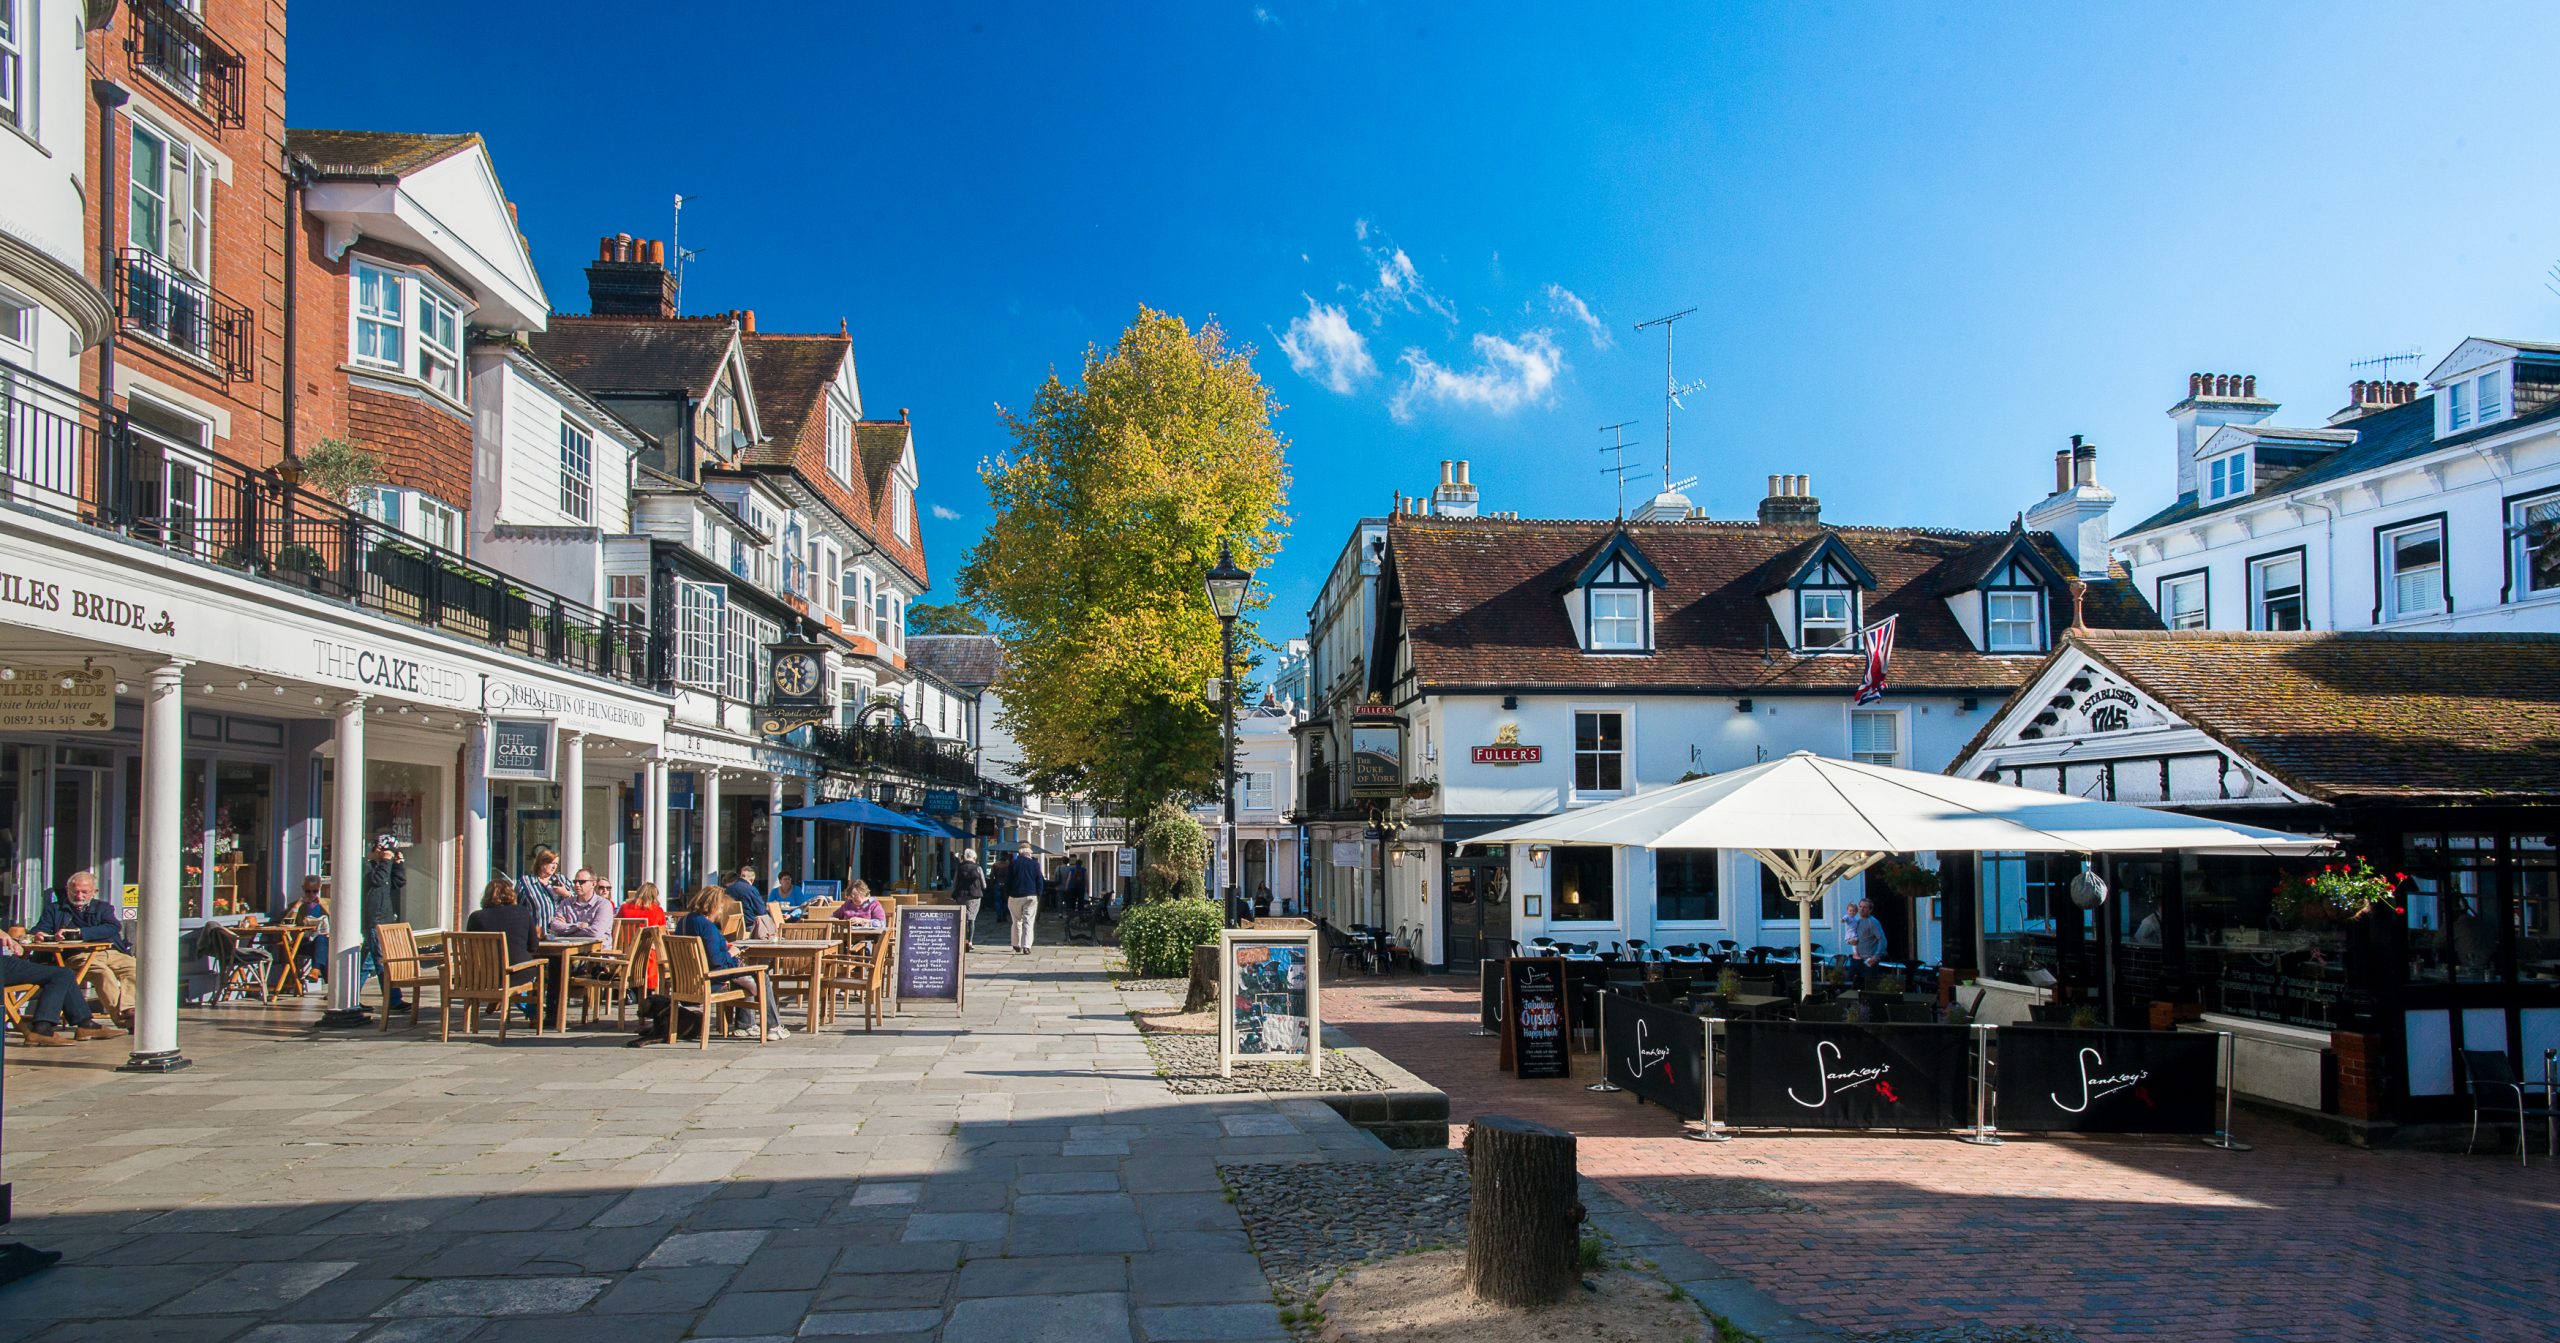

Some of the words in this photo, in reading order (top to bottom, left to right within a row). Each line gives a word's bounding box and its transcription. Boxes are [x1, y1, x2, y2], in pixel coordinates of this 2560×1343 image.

[0, 572, 59, 611] ILES
[72, 589, 146, 631] BRIDE
[15, 670, 48, 681] THE
[50, 684, 106, 697] BRIDE
[25, 698, 60, 710] bridal
[63, 701, 93, 710] wear
[511, 684, 542, 708] JOHN
[543, 691, 571, 713] LEWIS
[573, 697, 587, 716] OF
[588, 700, 645, 728] HUNGERFORD
[2079, 688, 2138, 717] ESTABLISHED
[4, 715, 34, 725] 01892
[38, 715, 55, 725] 514
[59, 715, 76, 725] 515
[2091, 705, 2129, 733] 1745
[499, 733, 524, 745] THE
[498, 744, 538, 756] CAKE
[1477, 748, 1537, 760] FULLER'S
[497, 755, 532, 767] SHED
[1357, 764, 1384, 773] DUKE
[392, 825, 412, 837] SALE
[1521, 1008, 1558, 1030] Oyster
[1523, 1027, 1543, 1040] Happy
